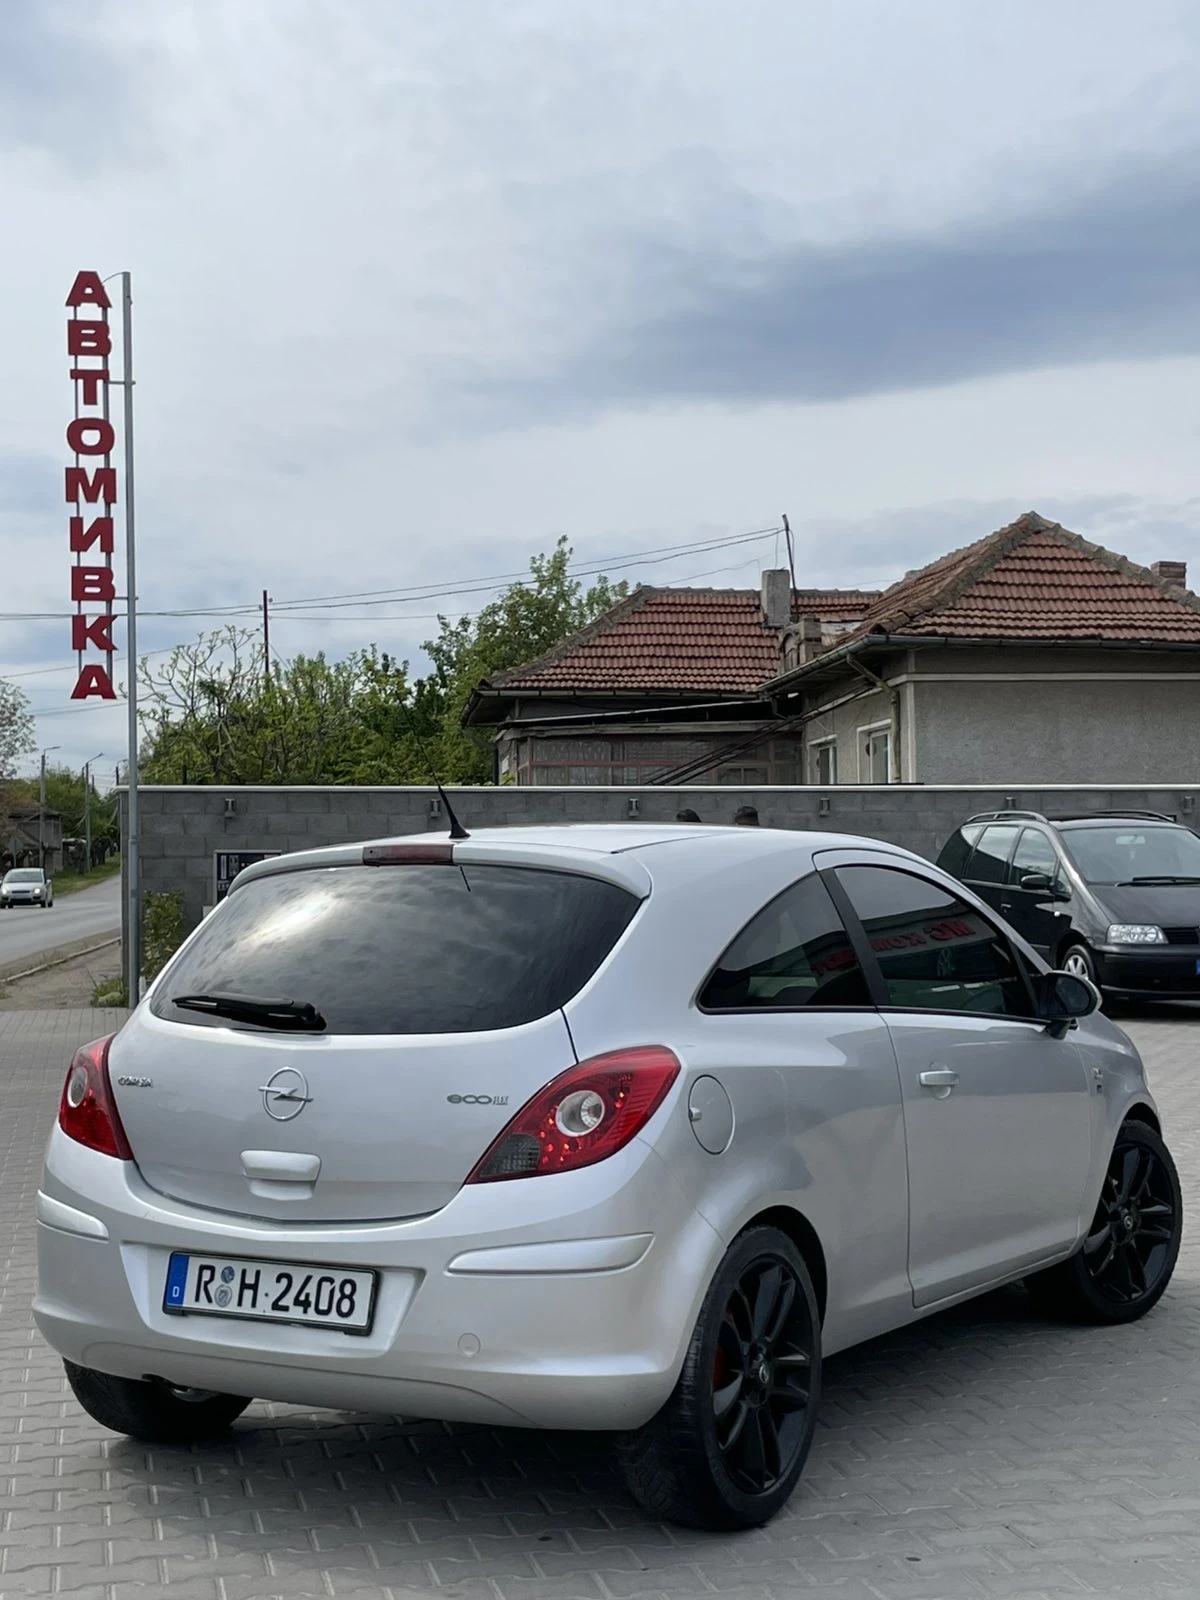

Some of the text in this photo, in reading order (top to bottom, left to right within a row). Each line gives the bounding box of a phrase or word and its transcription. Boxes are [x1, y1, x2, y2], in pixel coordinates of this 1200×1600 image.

[65, 270, 118, 700] АВТОМИВКА
[172, 1285, 180, 1298] D
[271, 1272, 357, 1319] 2408
